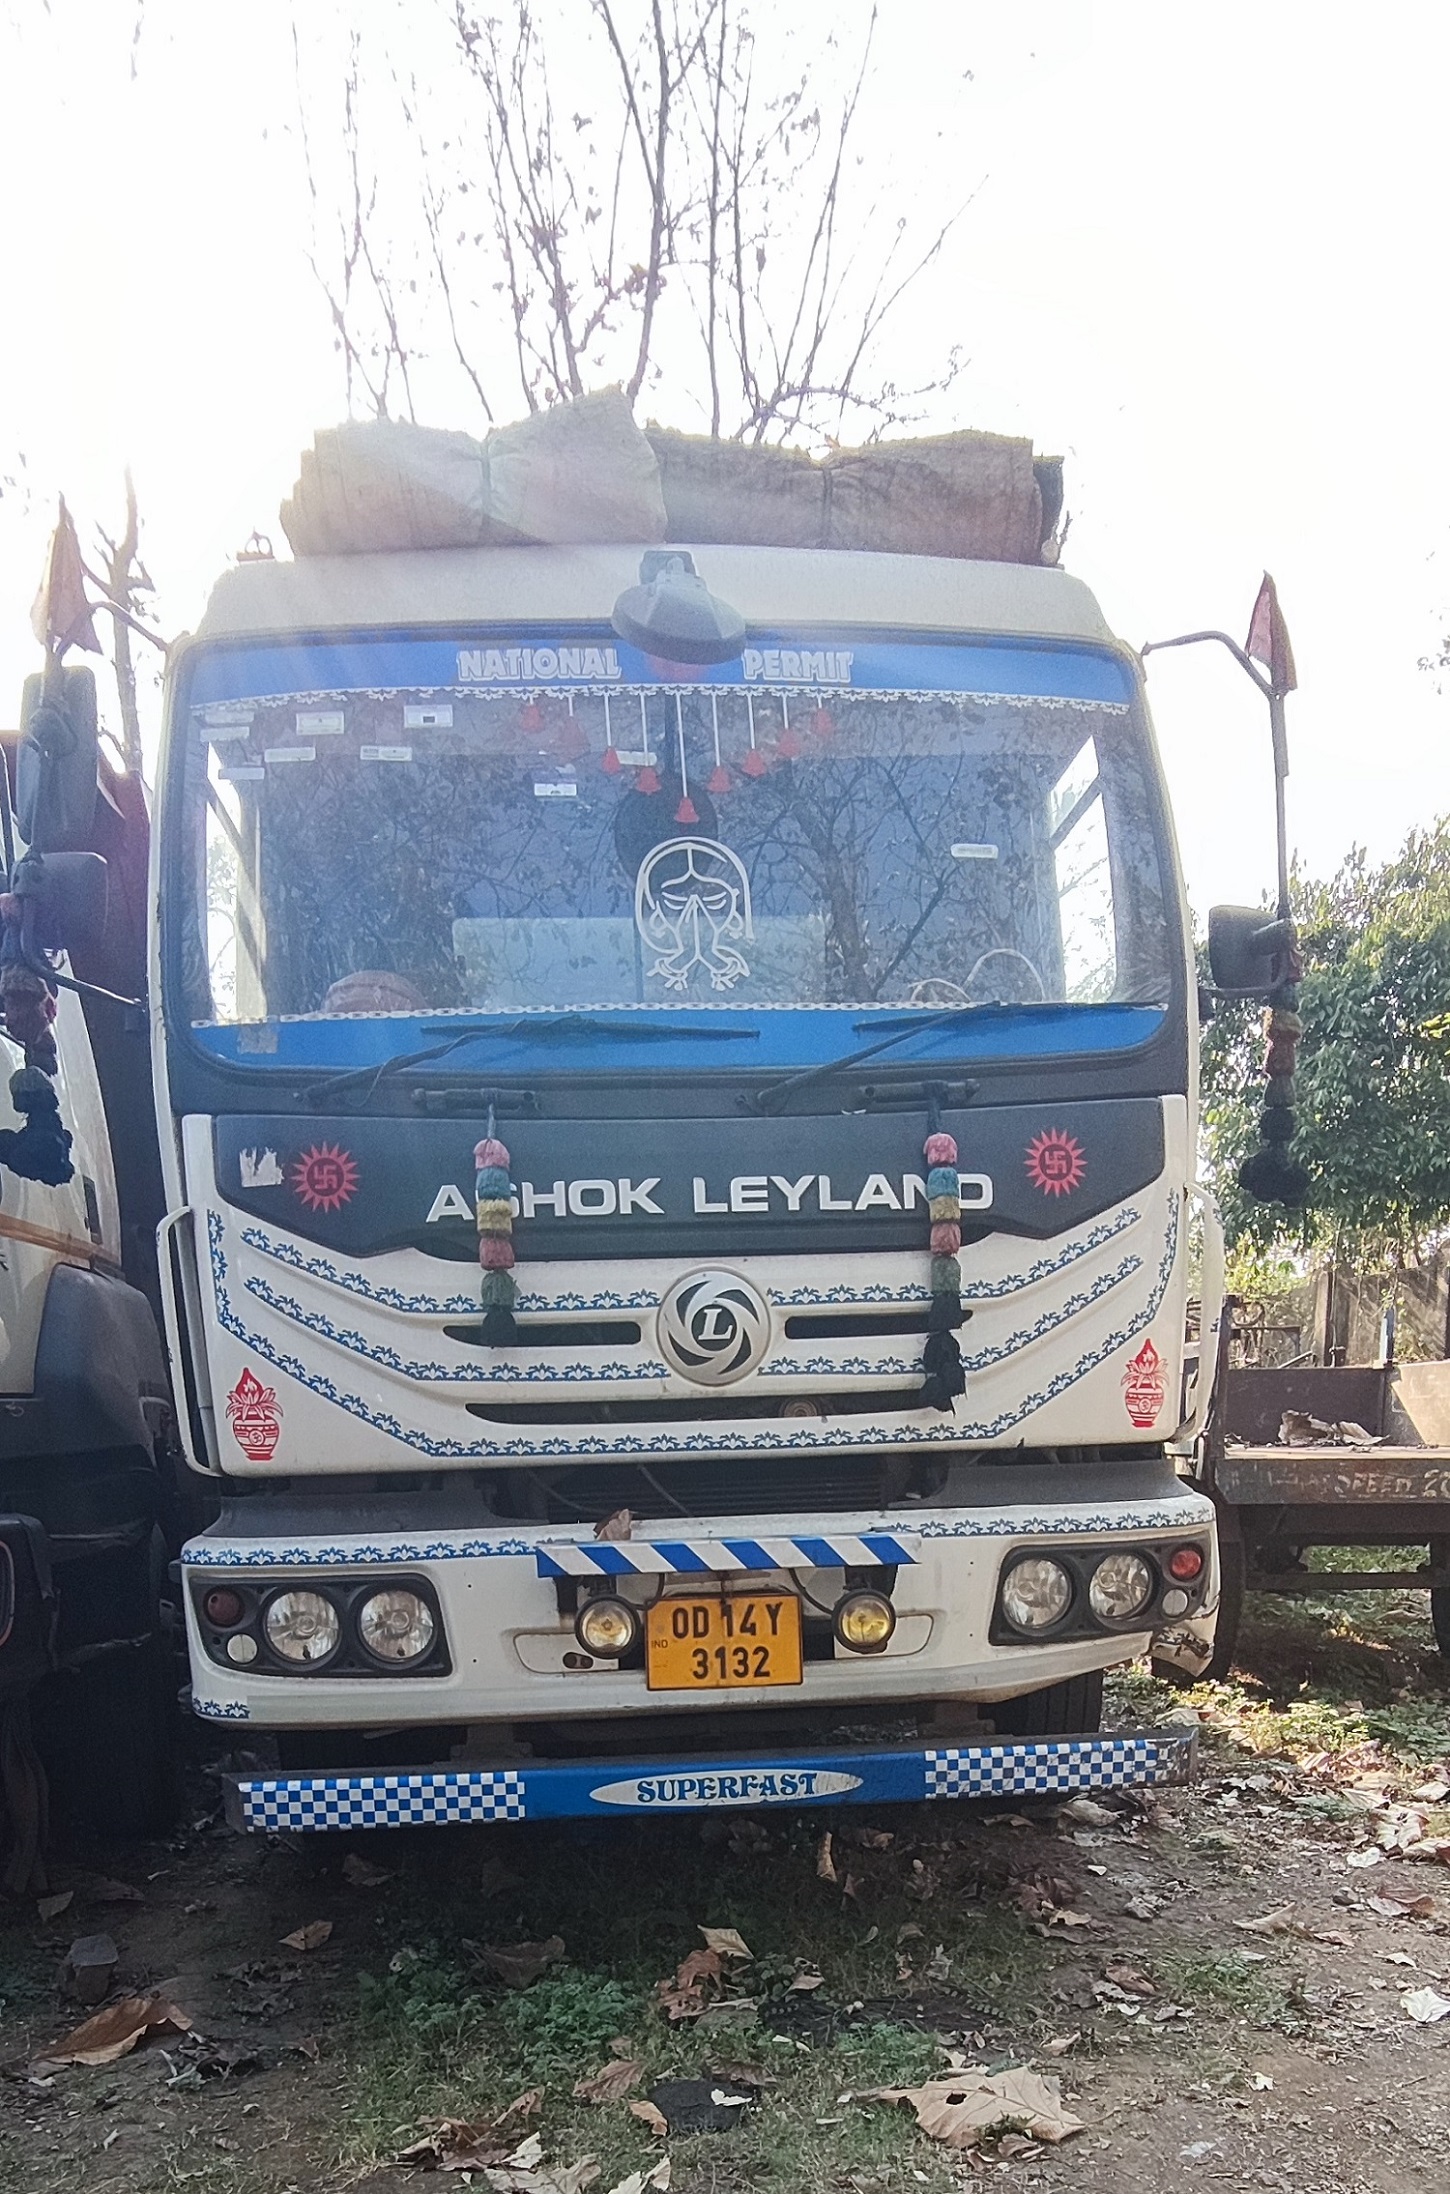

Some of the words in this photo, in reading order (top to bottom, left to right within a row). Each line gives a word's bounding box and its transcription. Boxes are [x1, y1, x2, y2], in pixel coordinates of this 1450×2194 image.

[456, 647, 622, 681] NATIONAL
[741, 648, 853, 683] PERMIT
[426, 1178, 665, 1223] AHOK
[651, 1639, 669, 1649] IND
[691, 1645, 771, 1680] 3132
[636, 1772, 818, 1803] SUPERFAST
